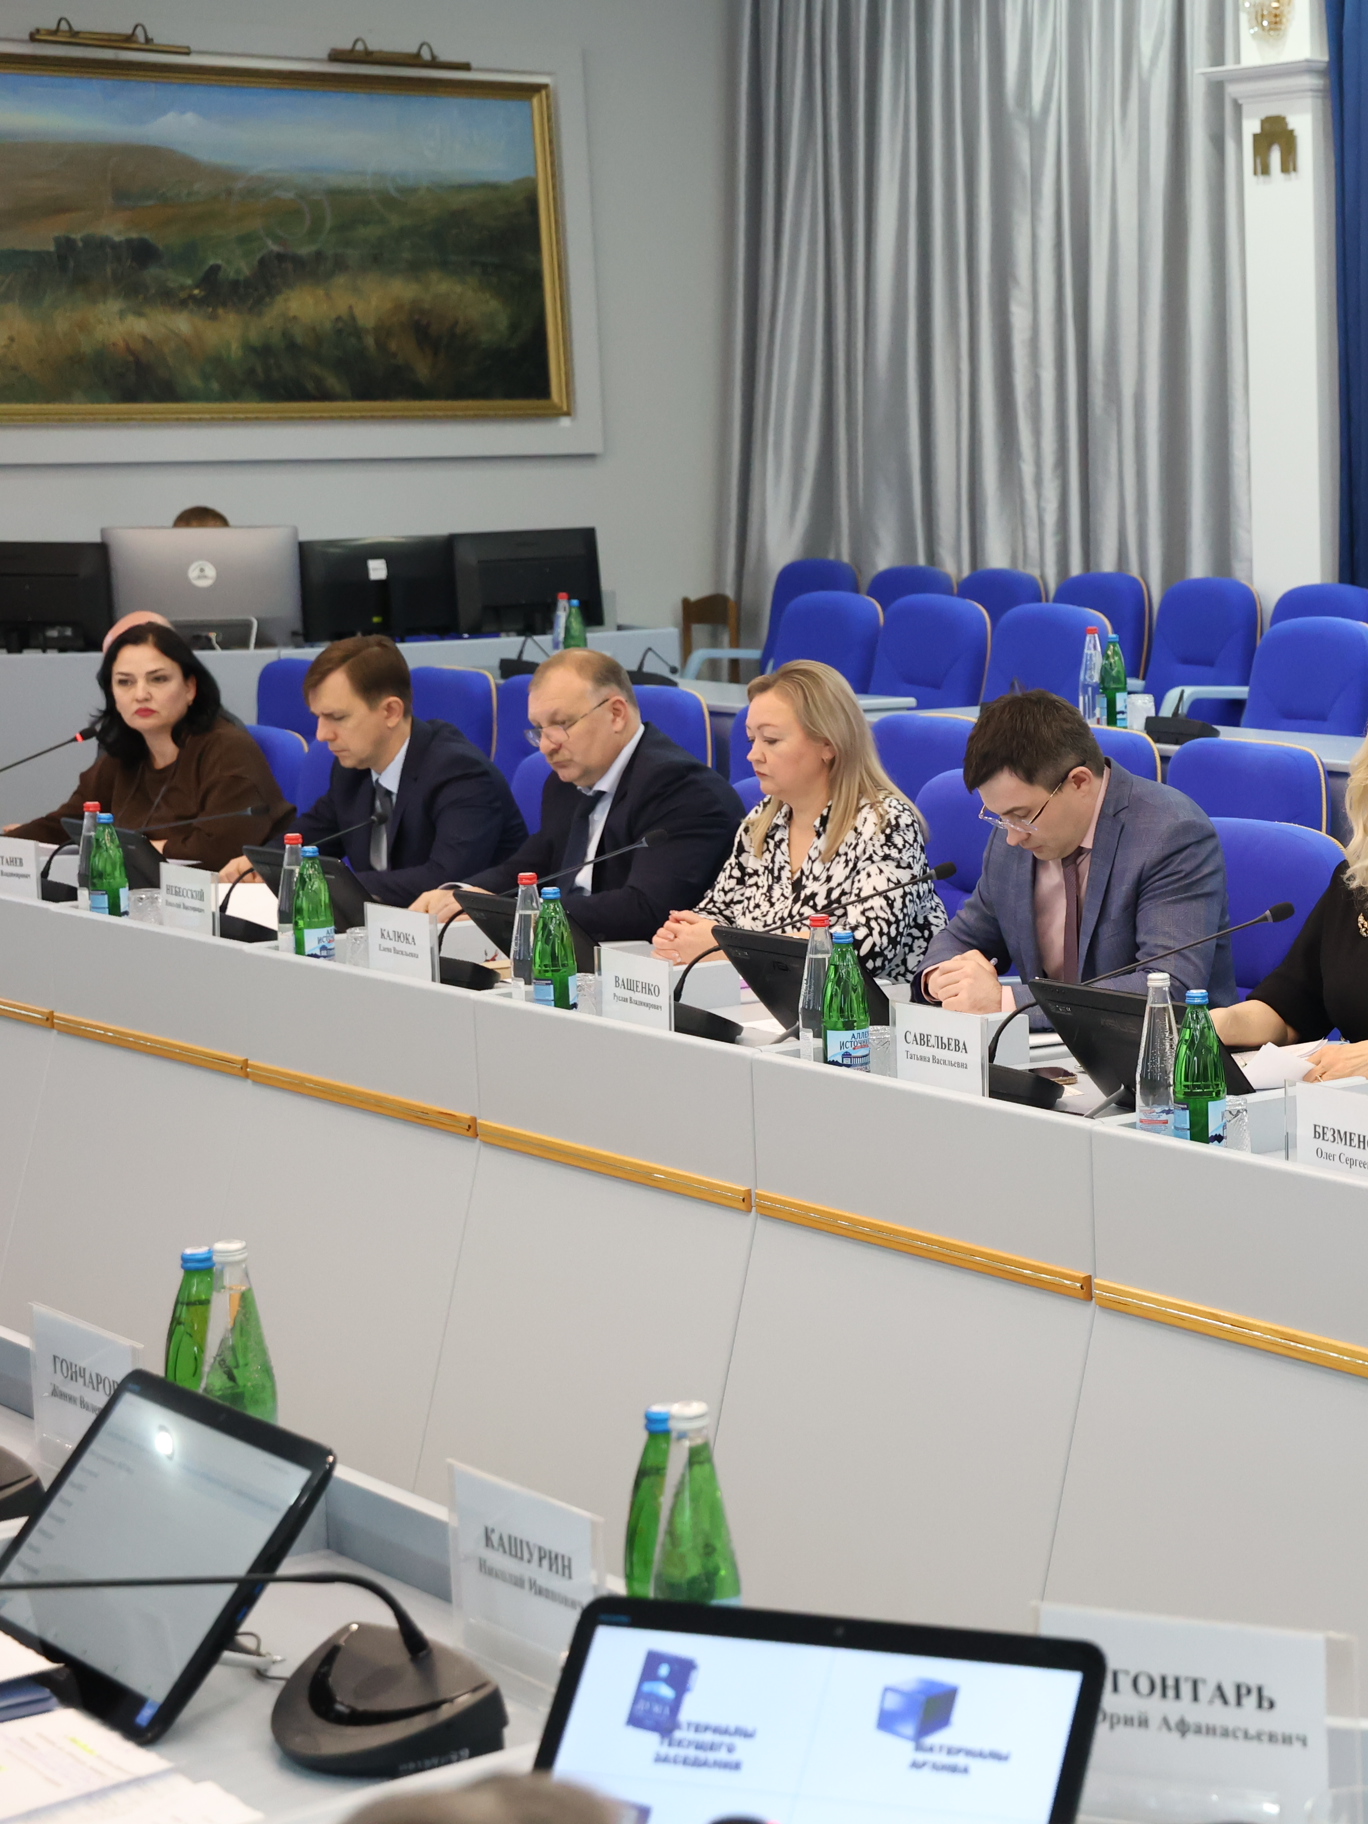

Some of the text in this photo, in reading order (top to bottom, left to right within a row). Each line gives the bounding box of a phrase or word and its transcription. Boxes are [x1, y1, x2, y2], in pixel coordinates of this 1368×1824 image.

[380, 928, 417, 946] КАЛЮКА
[614, 975, 661, 998] ВАЩЕНКО
[613, 993, 662, 1012] Руслан Владимирович
[904, 1030, 968, 1054] САВЕЛЬЕВА
[904, 1050, 969, 1070] Татьяна Васильевна
[1315, 1146, 1337, 1163] Олег
[483, 1525, 573, 1580] КАШУРИН
[1110, 1667, 1277, 1713] ГОНТАРЬ
[1156, 1713, 1309, 1749] Афанасьевич
